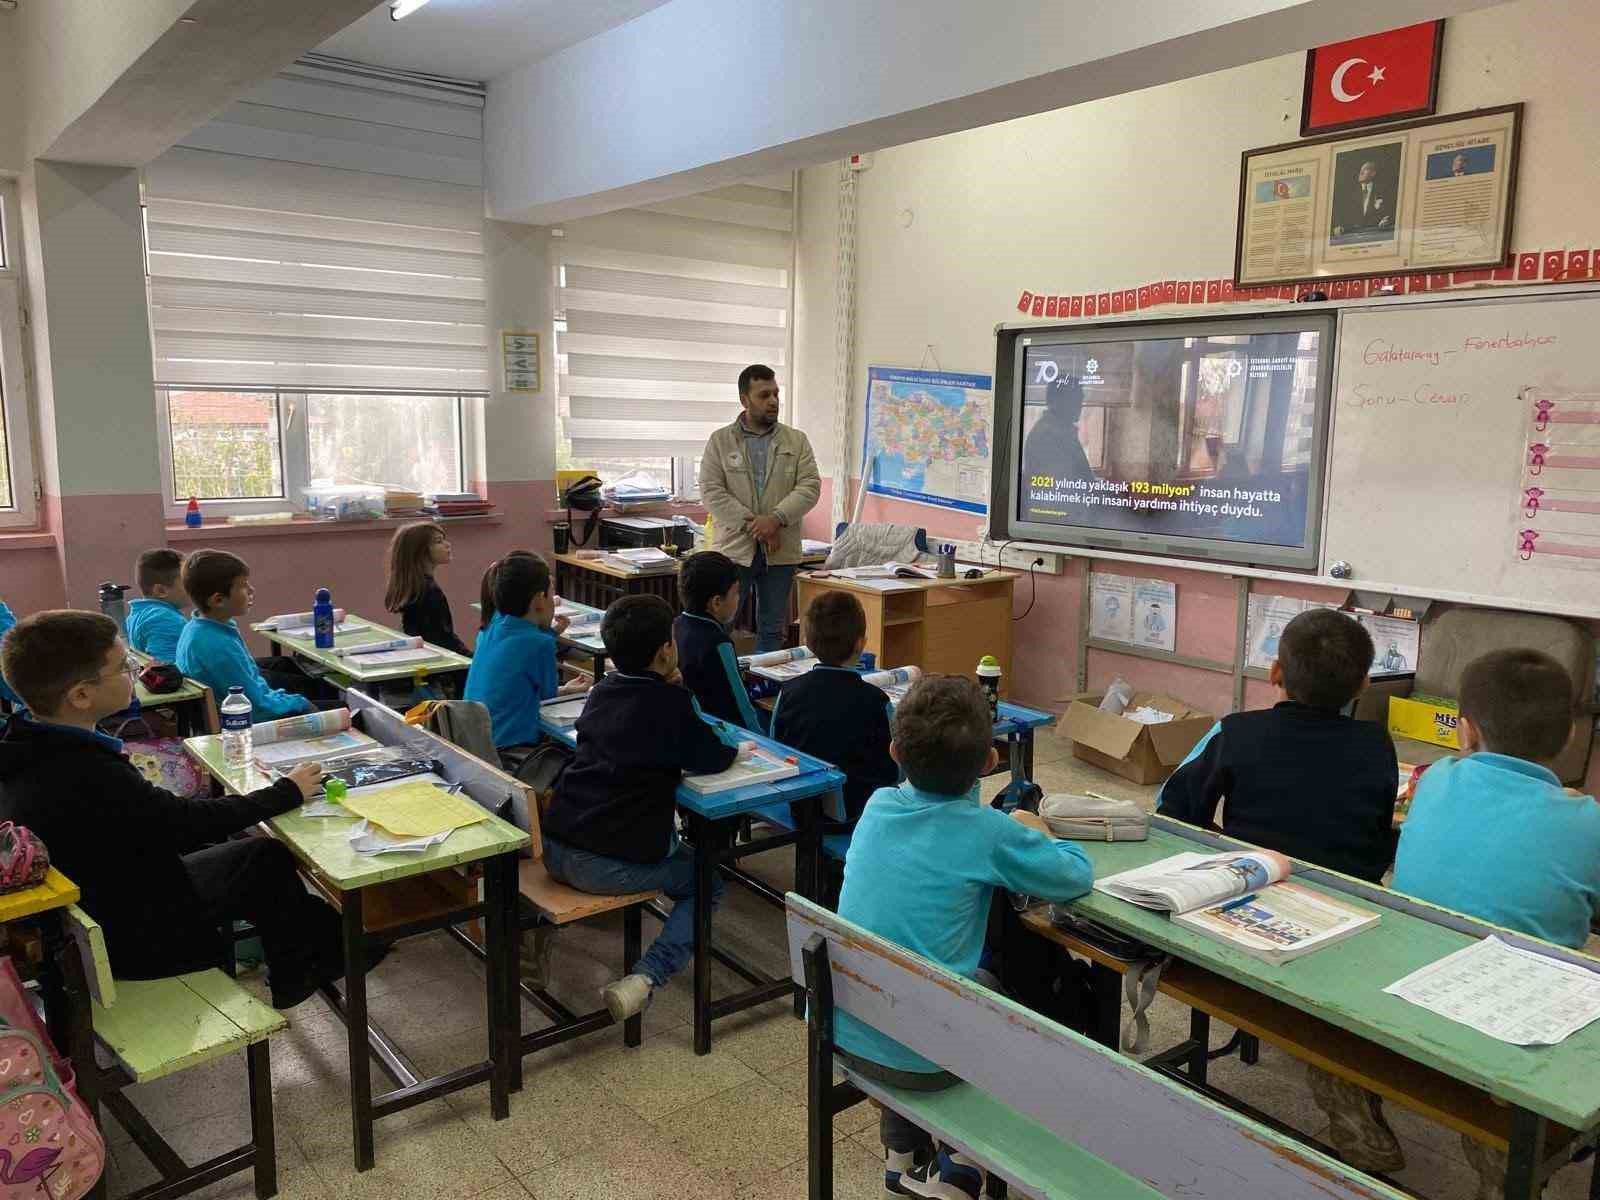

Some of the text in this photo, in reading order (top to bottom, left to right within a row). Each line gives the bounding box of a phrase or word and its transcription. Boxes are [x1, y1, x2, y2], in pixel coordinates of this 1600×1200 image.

[1035, 361, 1058, 383] 70
[1031, 475, 1054, 488] 2021
[1055, 478, 1087, 490] yılında
[1088, 480, 1129, 494] yaklaşık
[1131, 482, 1150, 494] 193
[1200, 486, 1231, 499] insan
[1233, 488, 1281, 504] hayatta
[1030, 490, 1264, 518] kalabilmek için insani yardıma ihtiyaç duydu.
